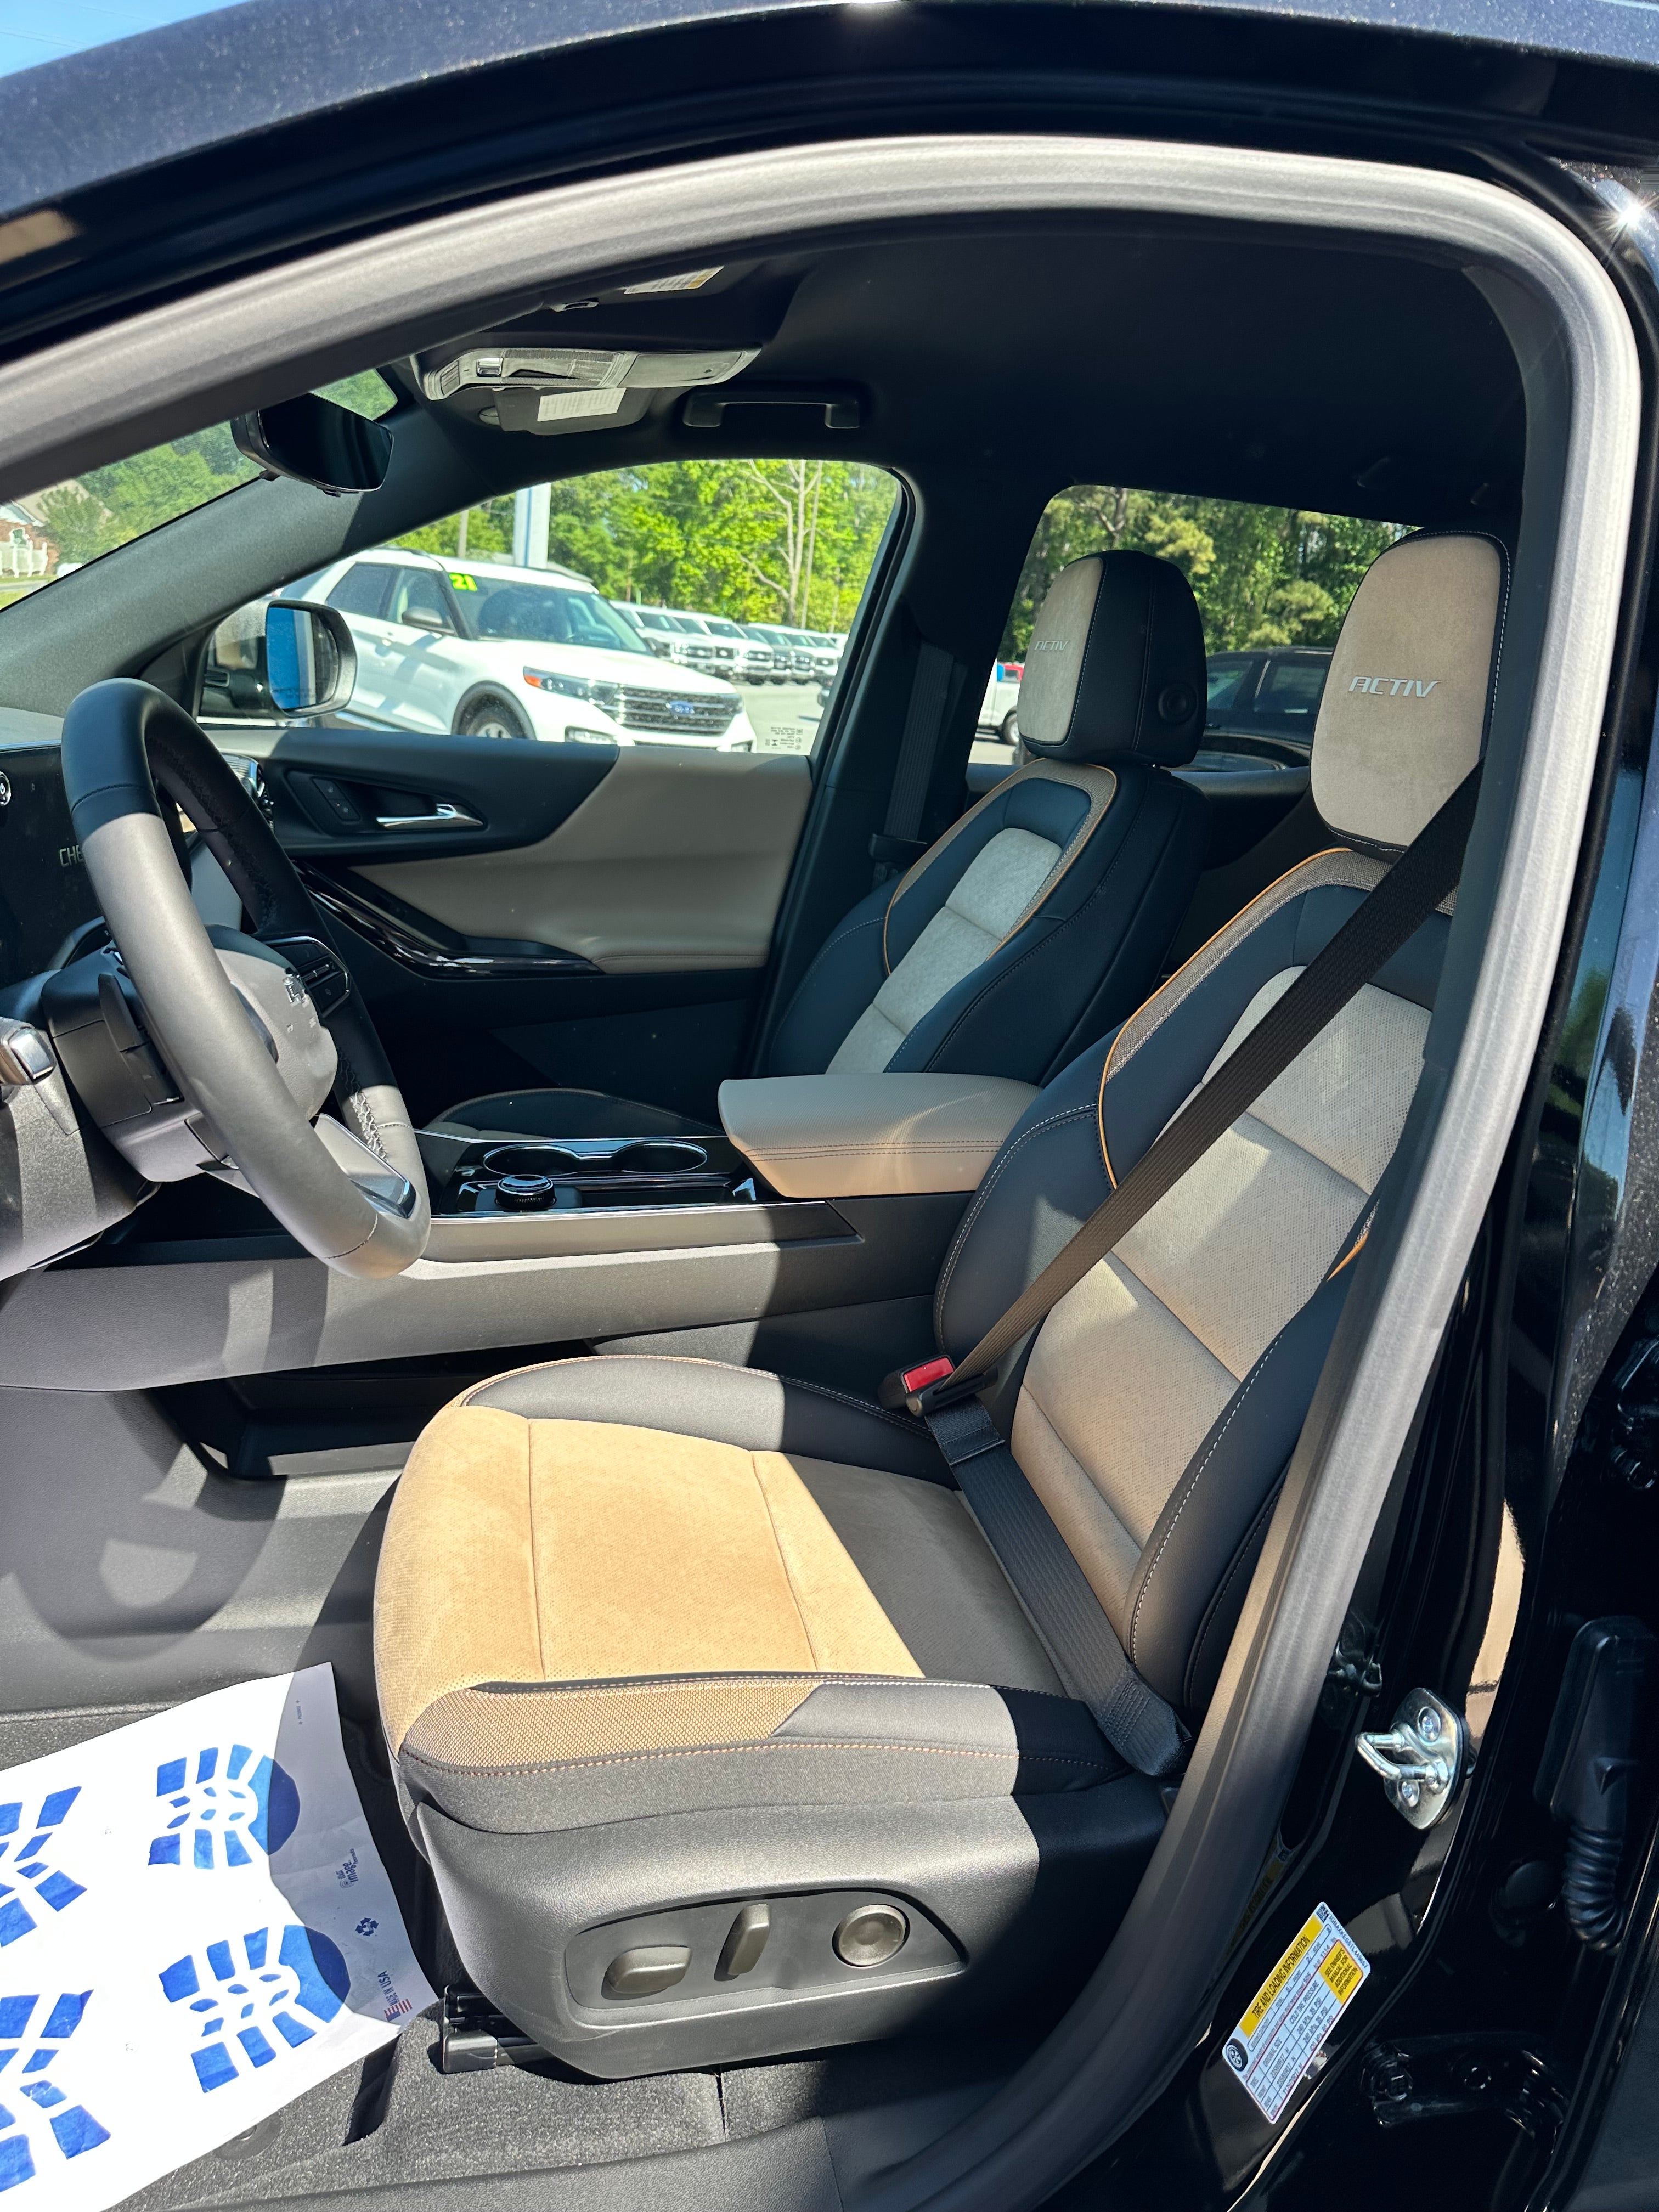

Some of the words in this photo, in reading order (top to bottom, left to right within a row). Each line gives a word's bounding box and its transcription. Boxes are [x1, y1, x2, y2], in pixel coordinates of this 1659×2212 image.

[449, 573, 478, 591] 21
[1034, 640, 1070, 651] ACTIV
[1348, 675, 1442, 697] ACTIV
[343, 1861, 359, 1883] image
[377, 1970, 392, 1988] USA
[1251, 2002, 1264, 2021] TIRE
[1259, 1990, 1271, 2008] AND
[1266, 1967, 1286, 1997] LOADING
[1282, 1933, 1310, 1974] INFORMATION
[1302, 1971, 1312, 1984] 505
[383, 1986, 395, 1995] IN
